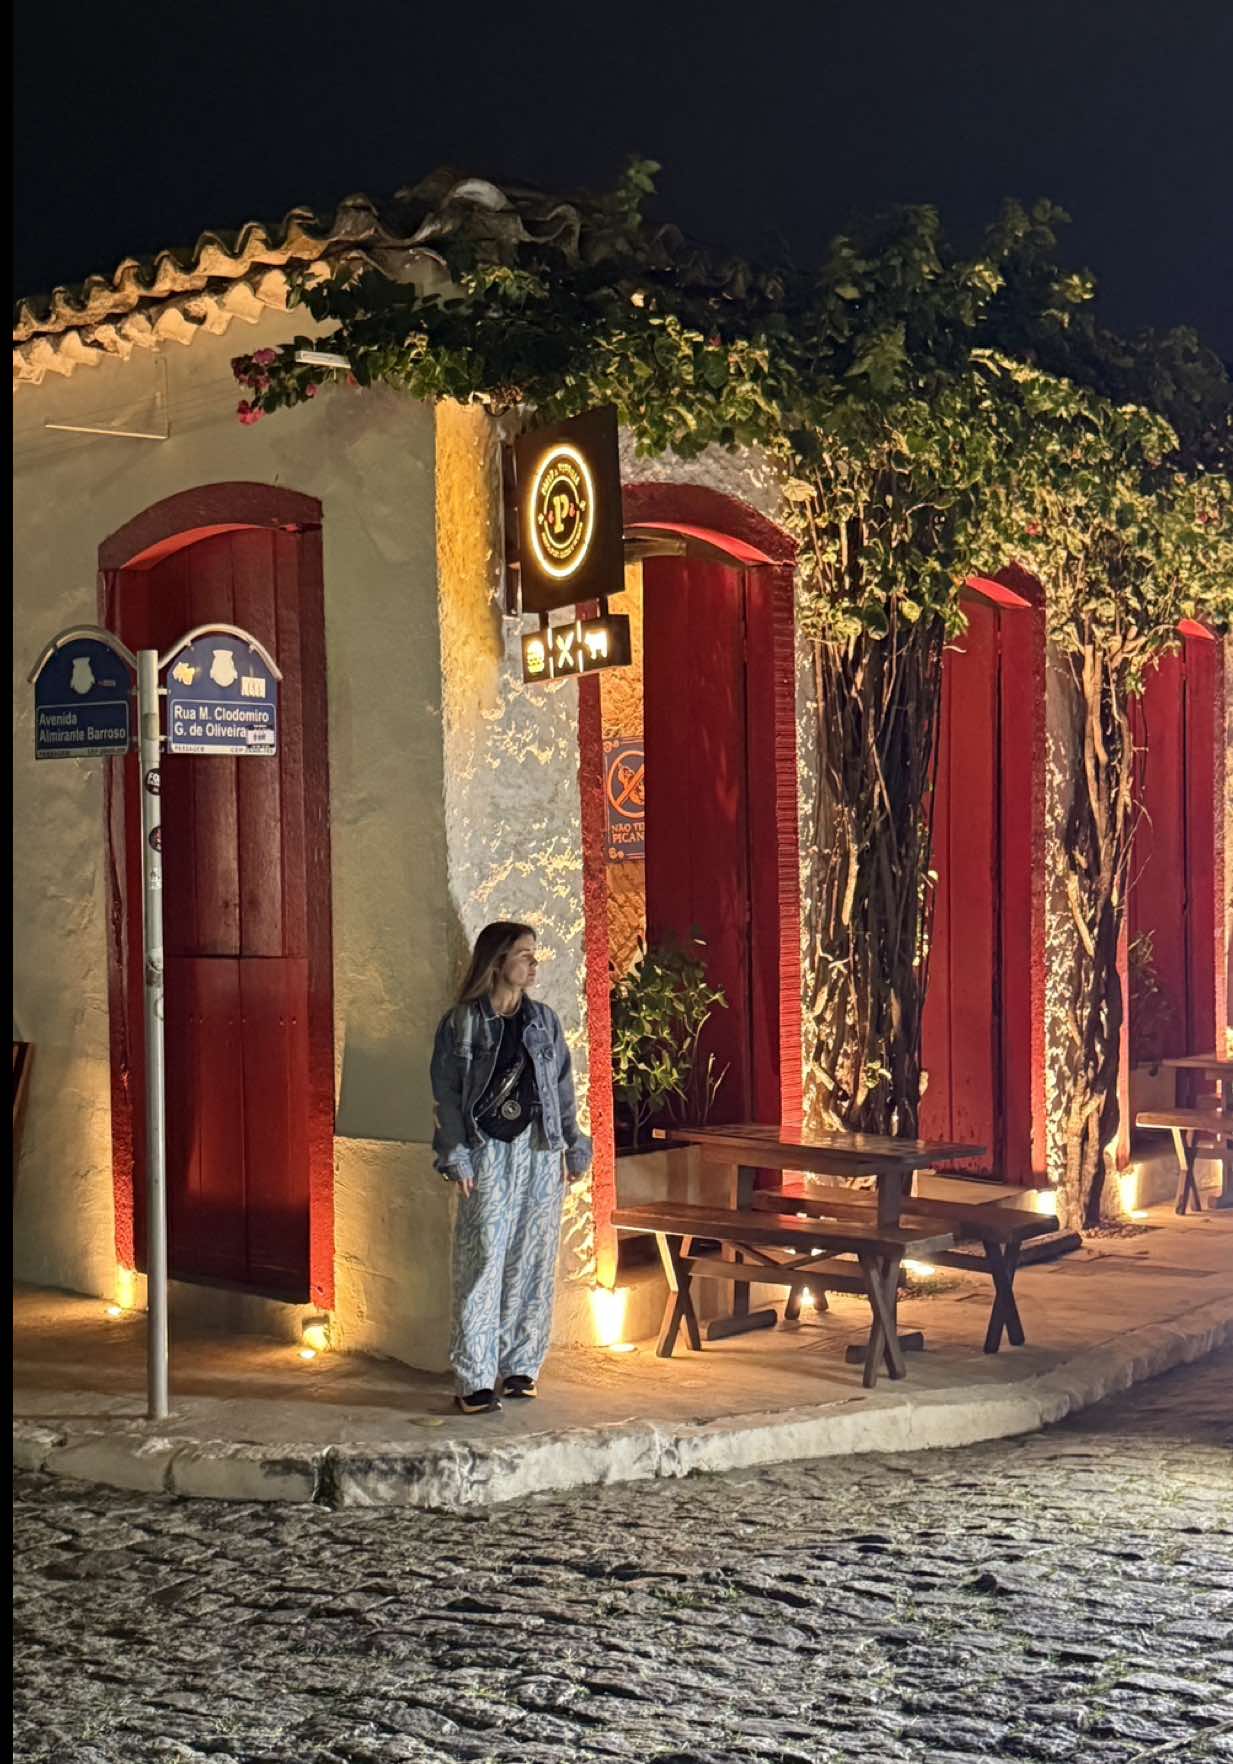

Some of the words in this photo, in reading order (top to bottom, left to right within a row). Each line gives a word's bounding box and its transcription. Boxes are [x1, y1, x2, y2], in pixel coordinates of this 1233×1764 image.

[40, 712, 78, 726] Avenida
[174, 705, 196, 720] Rua
[199, 706, 212, 720] M.
[214, 706, 269, 722] Clodomiro
[40, 728, 85, 743] Almirante
[87, 726, 126, 741] Barroso
[174, 722, 187, 736] G.
[189, 722, 203, 737] de
[206, 722, 247, 738] Oliveira
